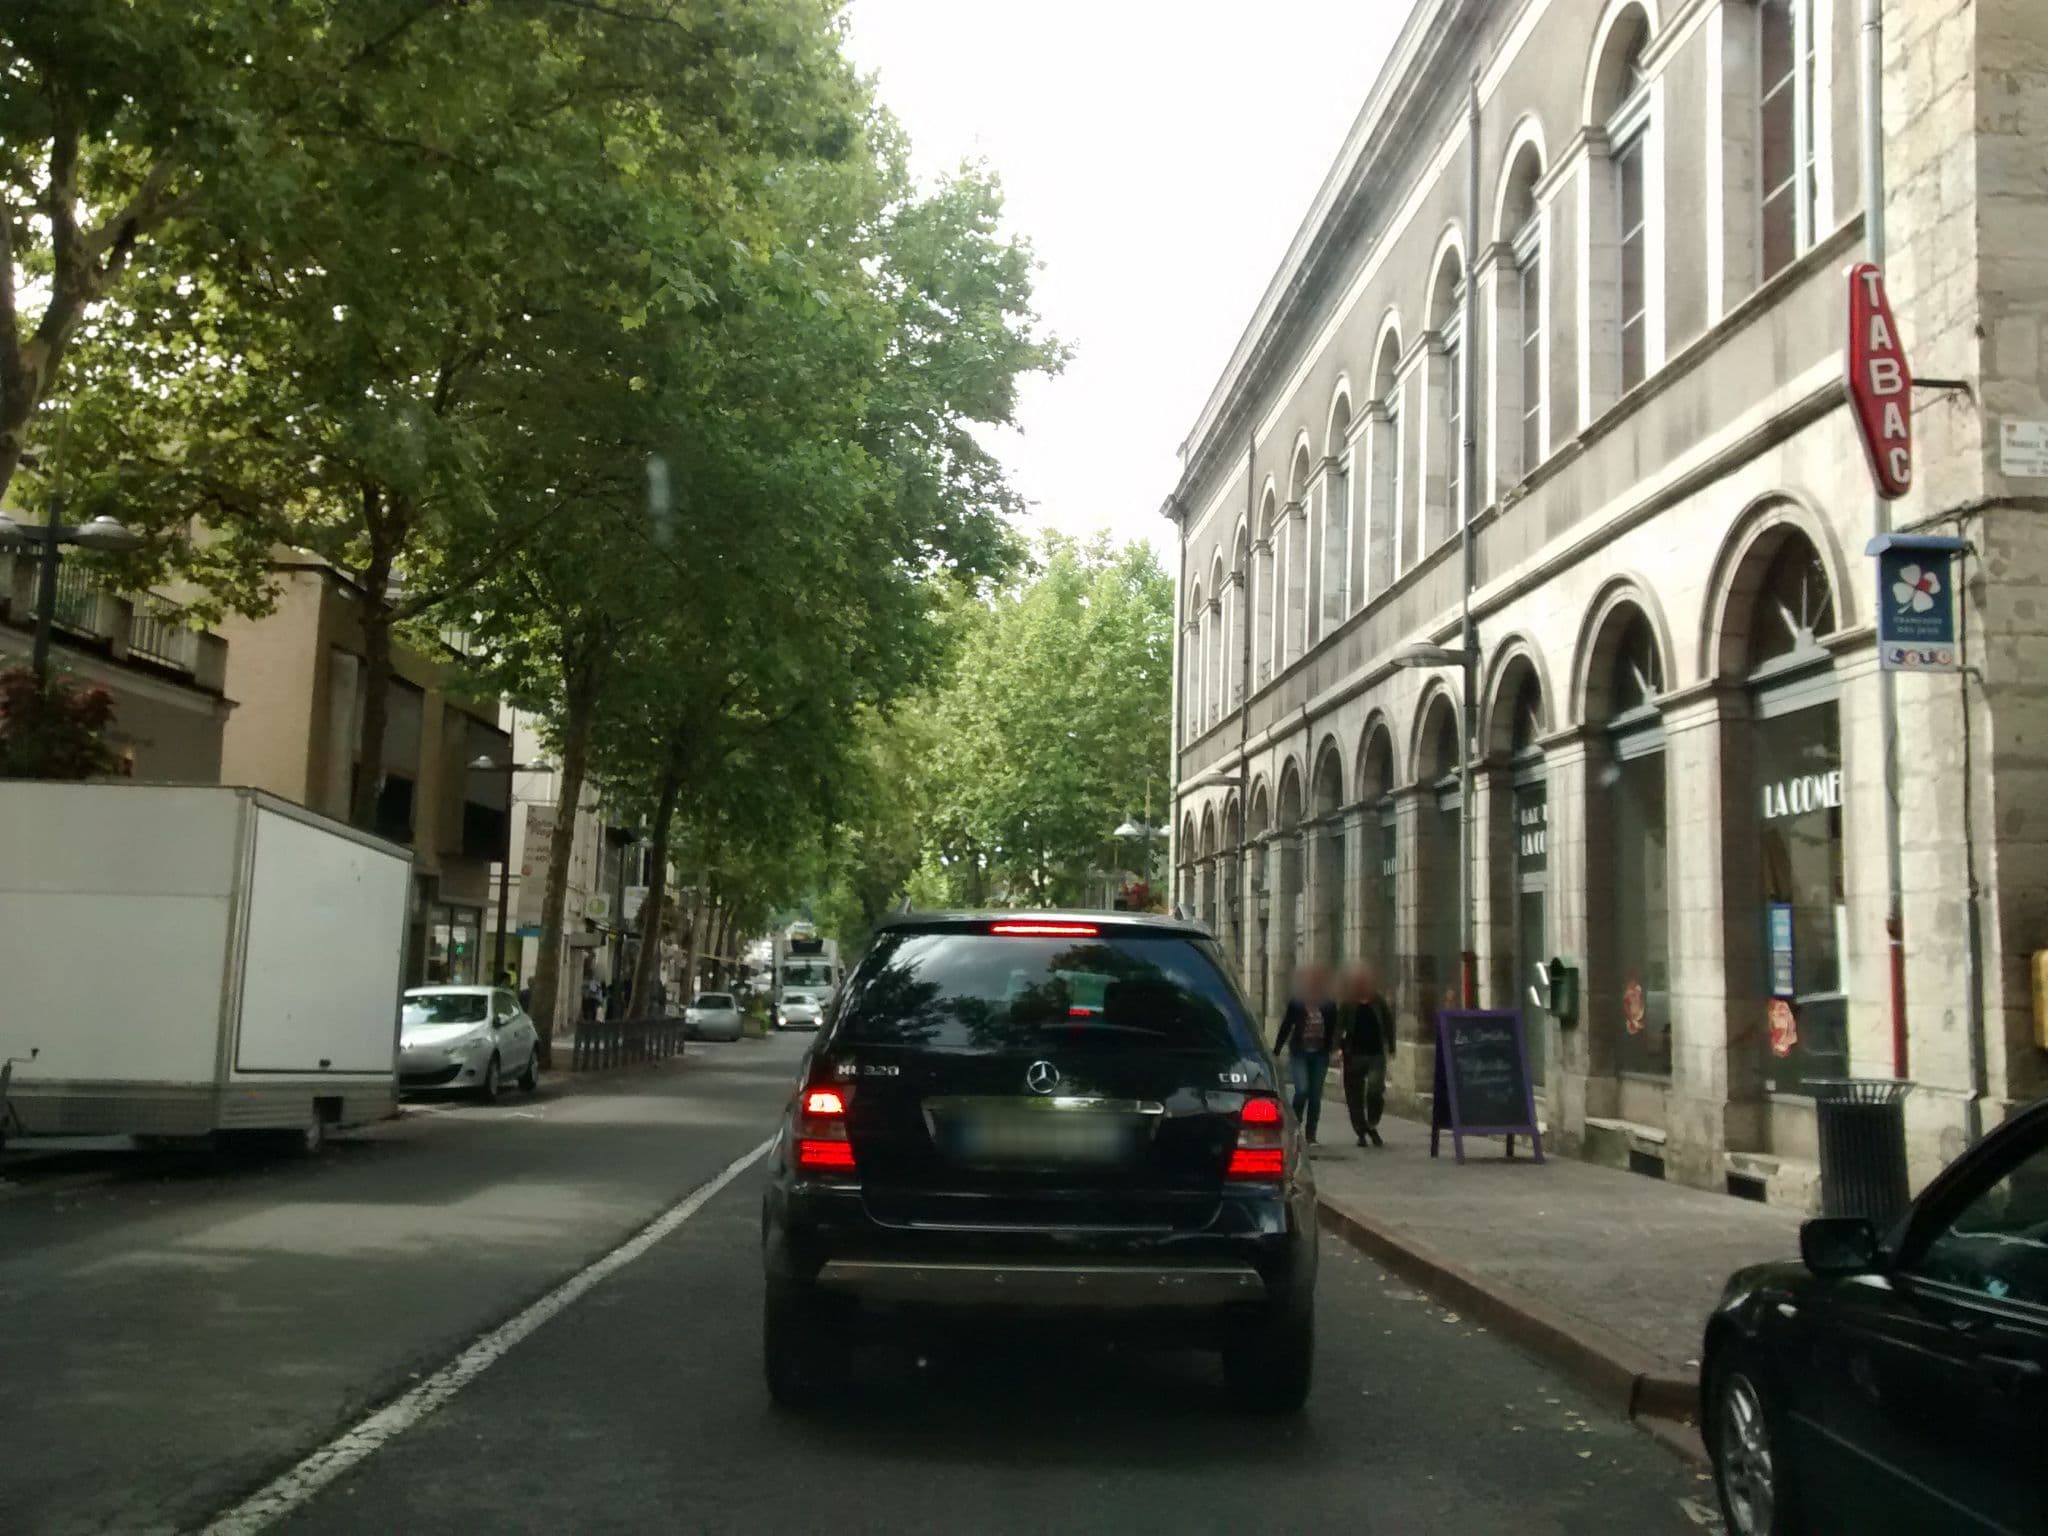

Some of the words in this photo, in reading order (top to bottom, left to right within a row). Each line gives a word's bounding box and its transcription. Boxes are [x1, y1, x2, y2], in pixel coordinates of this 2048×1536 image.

[1862, 271, 1910, 484] TABAC
[1764, 781, 1789, 819] LA
[1218, 1073, 1247, 1083] CDI
